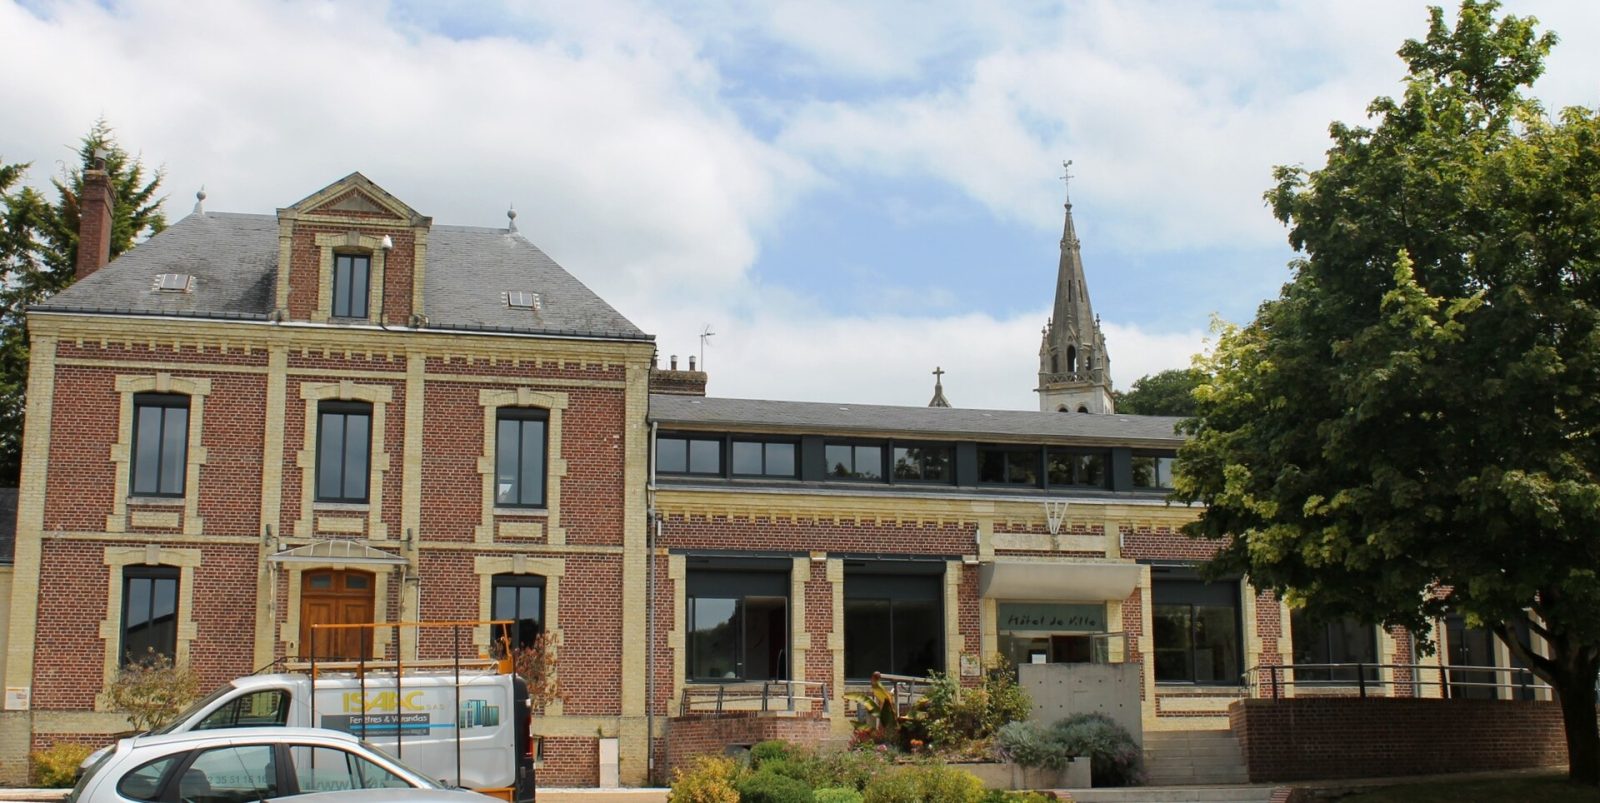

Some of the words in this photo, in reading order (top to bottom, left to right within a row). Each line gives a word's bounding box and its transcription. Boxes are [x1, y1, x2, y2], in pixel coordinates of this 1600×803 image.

[1008, 614, 1044, 626] Hôtel
[1049, 616, 1064, 626] de
[1067, 615, 1097, 626] Ville
[391, 714, 428, 723] Vrandas
